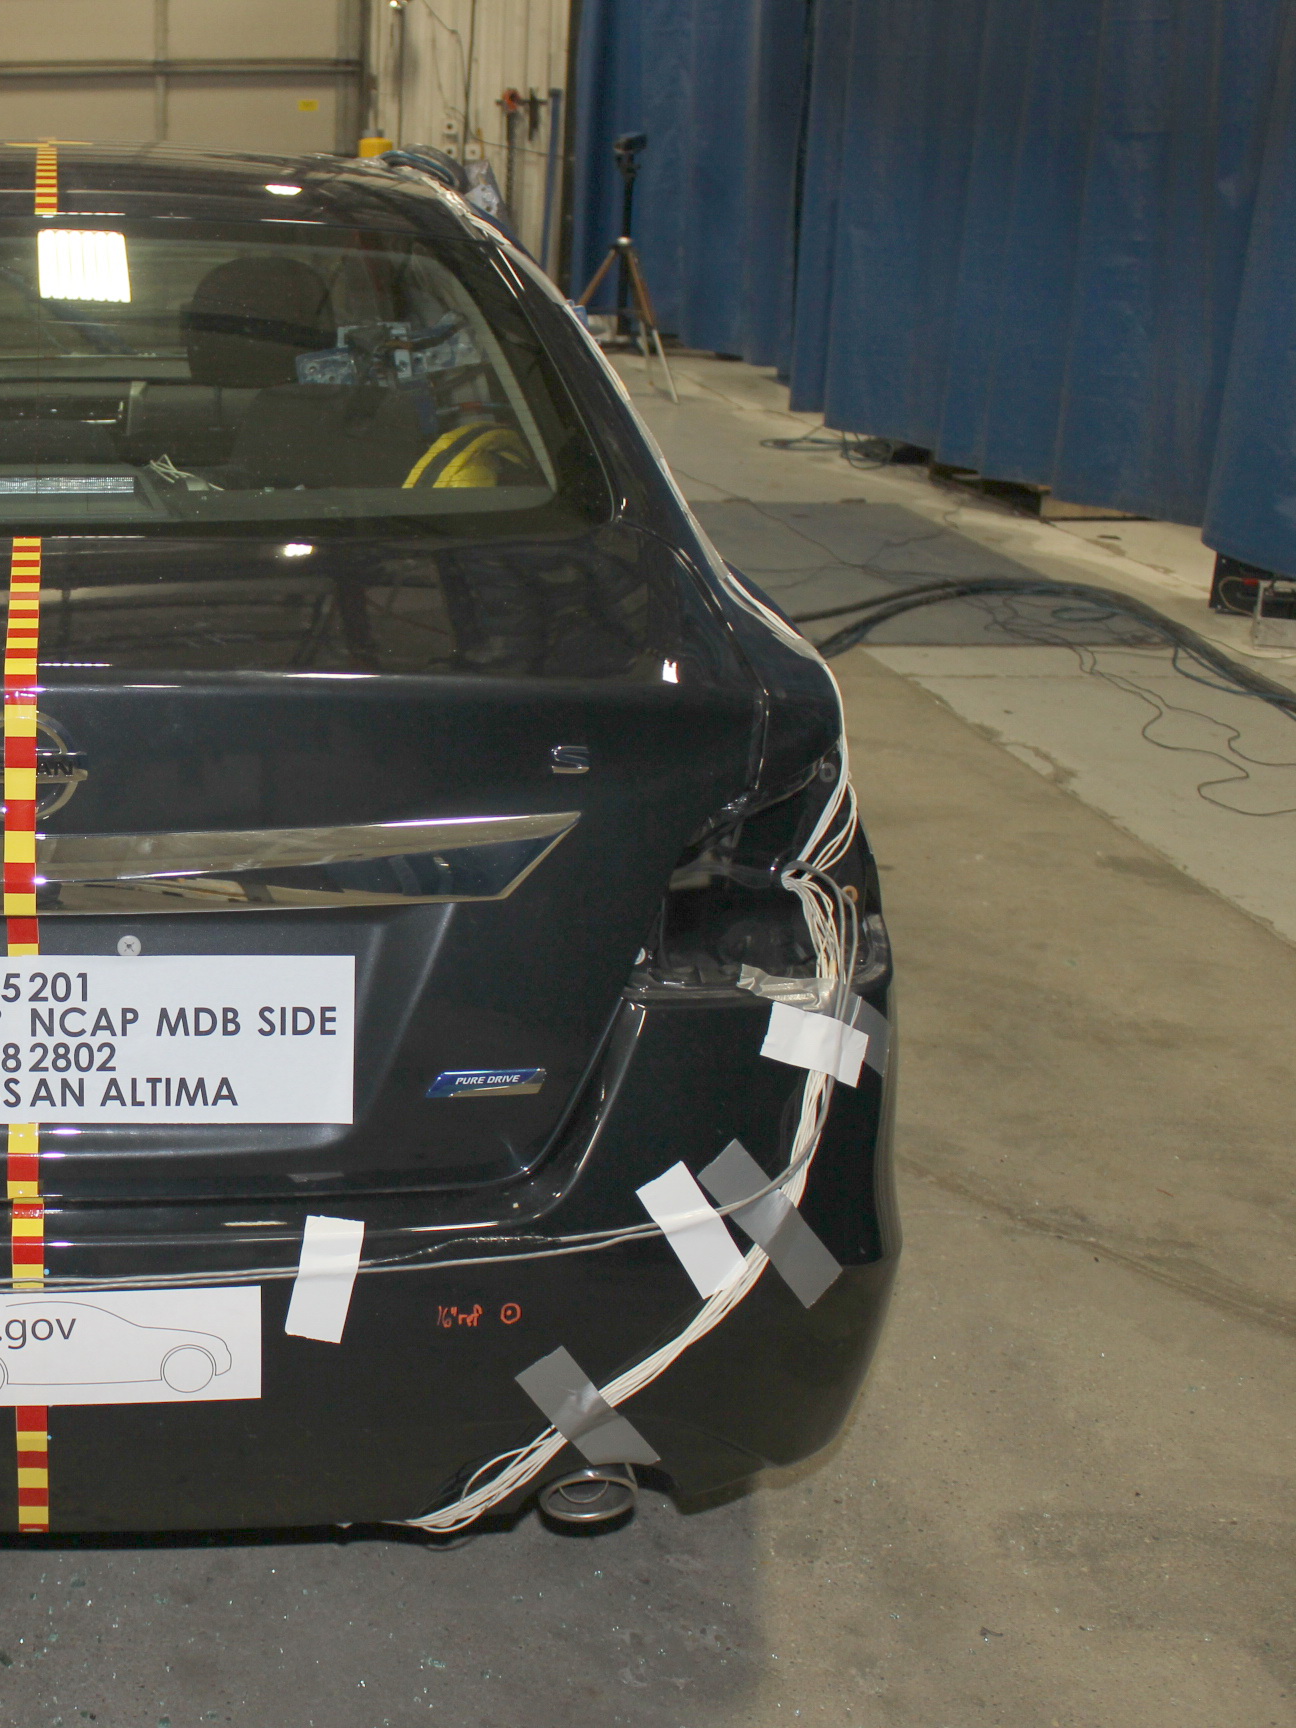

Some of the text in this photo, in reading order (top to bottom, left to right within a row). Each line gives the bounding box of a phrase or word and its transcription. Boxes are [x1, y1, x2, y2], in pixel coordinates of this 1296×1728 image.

[551, 745, 590, 774] S
[30, 1007, 139, 1037] NCAP
[156, 1007, 241, 1037] MDB
[257, 1006, 337, 1037] SIDE
[100, 1077, 239, 1107] ALTIMA
[455, 1075, 521, 1085] PURE DRIVE
